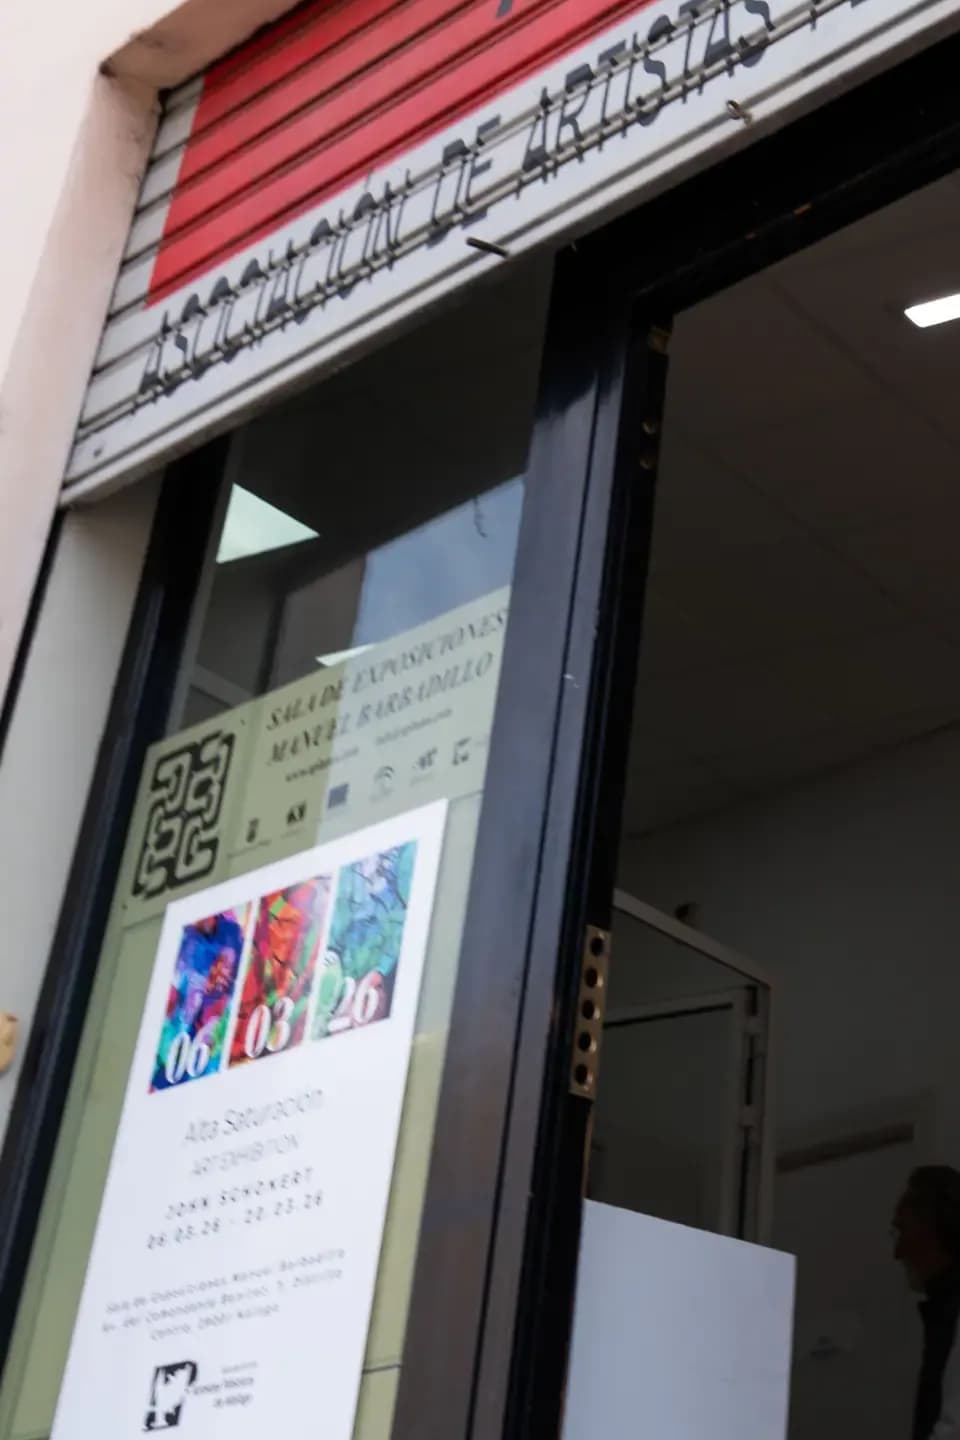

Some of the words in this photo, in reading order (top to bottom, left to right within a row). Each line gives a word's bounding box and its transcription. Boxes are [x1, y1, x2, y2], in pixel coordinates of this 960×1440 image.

[427, 112, 502, 250] DE
[165, 1018, 217, 1084] 06
[244, 996, 295, 1059] 03
[327, 971, 381, 1033] 26
